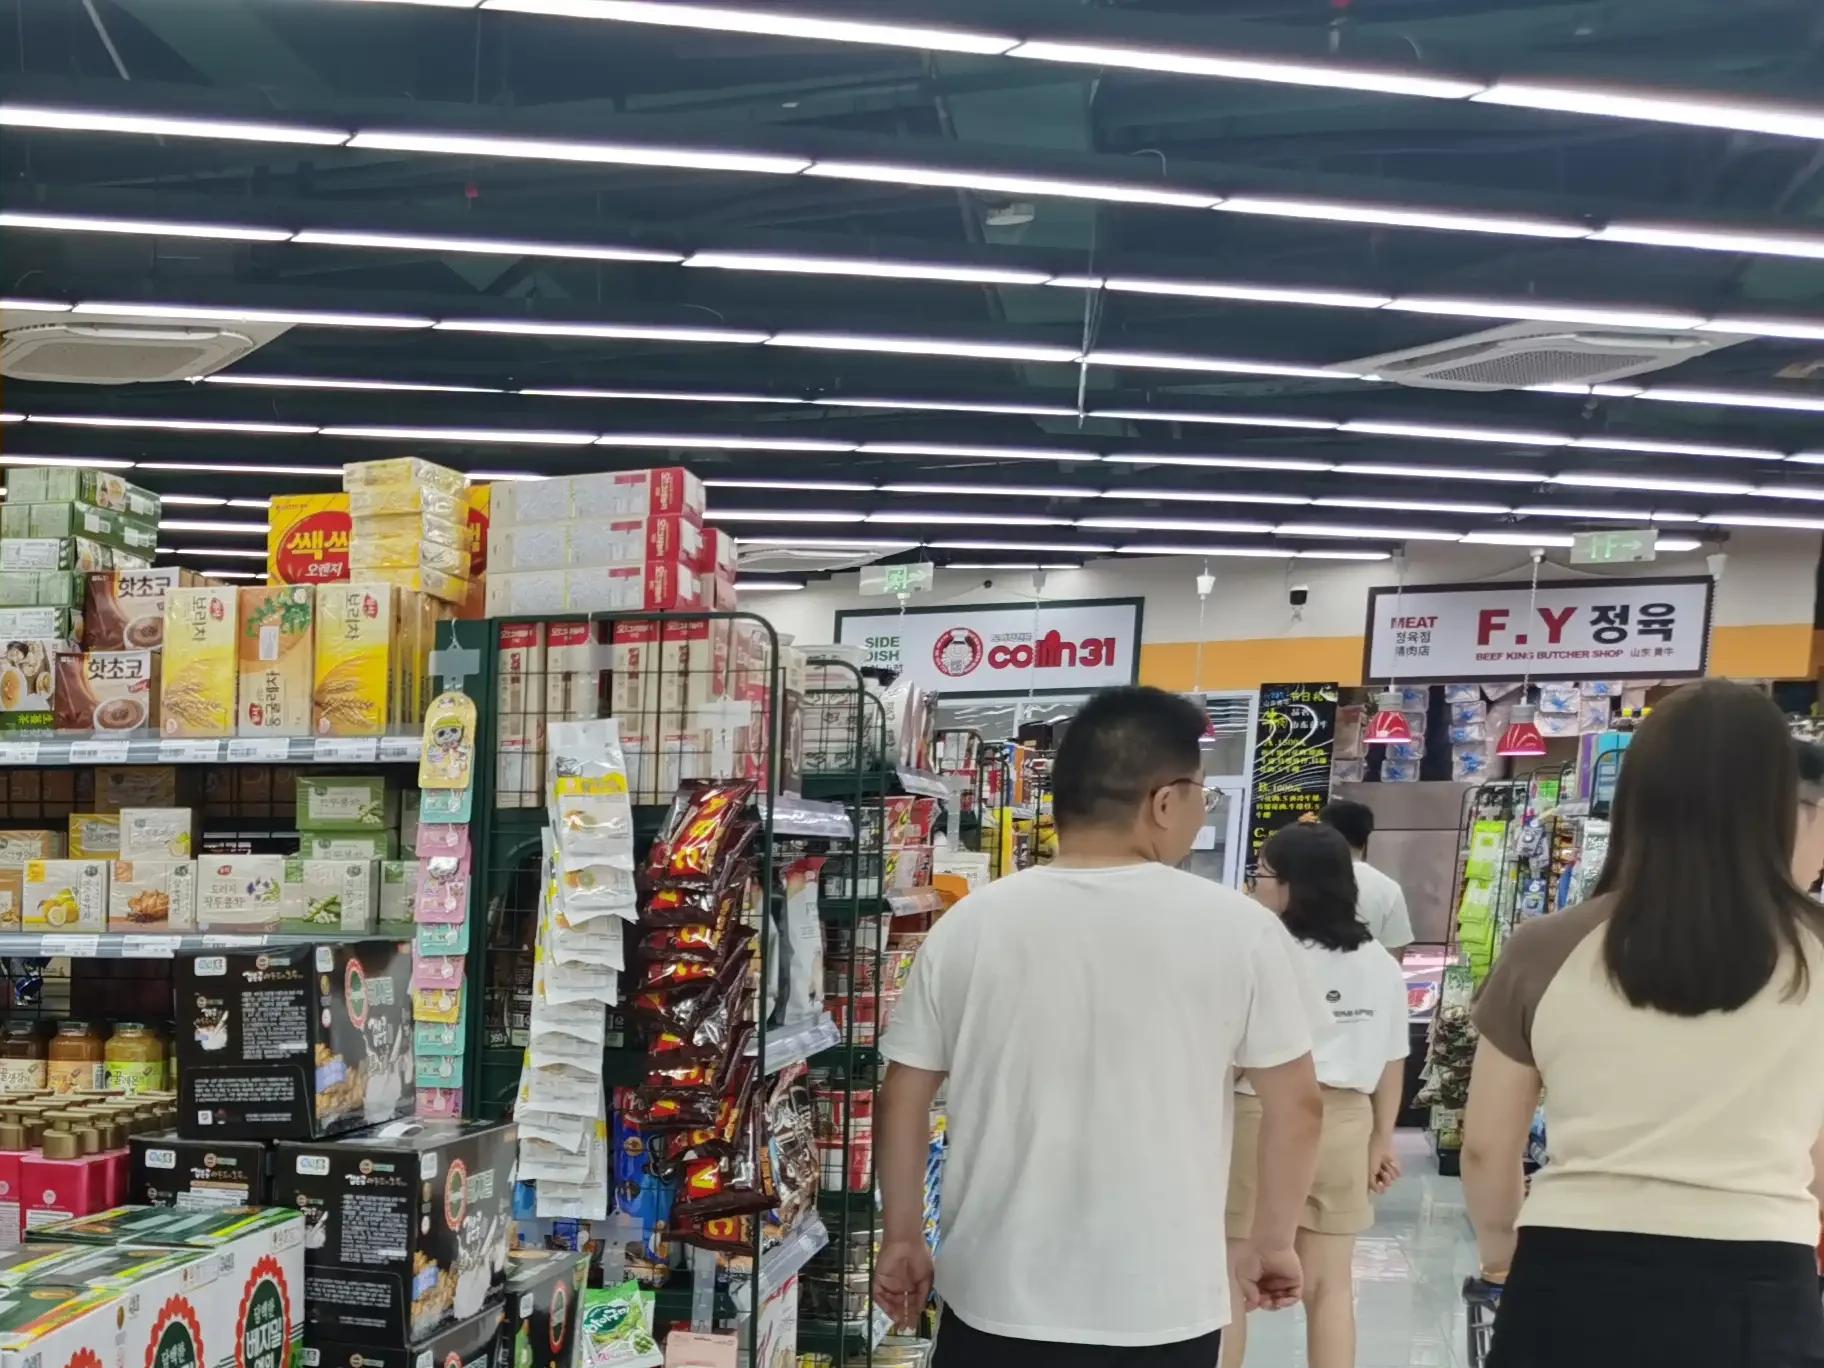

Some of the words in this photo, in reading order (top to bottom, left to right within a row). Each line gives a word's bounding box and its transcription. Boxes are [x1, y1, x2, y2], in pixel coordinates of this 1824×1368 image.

[305, 563, 342, 578] 오렌지
[118, 576, 170, 598] 핫초코
[191, 595, 208, 643] 보리차
[344, 593, 361, 641] 보리차
[1390, 616, 1438, 629] MEAT
[1477, 607, 1578, 645] F.Y
[1590, 602, 1676, 644] 정육
[865, 636, 900, 648] SIDE
[1395, 631, 1431, 643] 정육점
[1476, 651, 1503, 661] BEEF
[1506, 651, 1534, 660] KING
[1536, 650, 1590, 660] BUTCHER
[1592, 649, 1624, 659] SHOP
[87, 657, 143, 680] 핫초코
